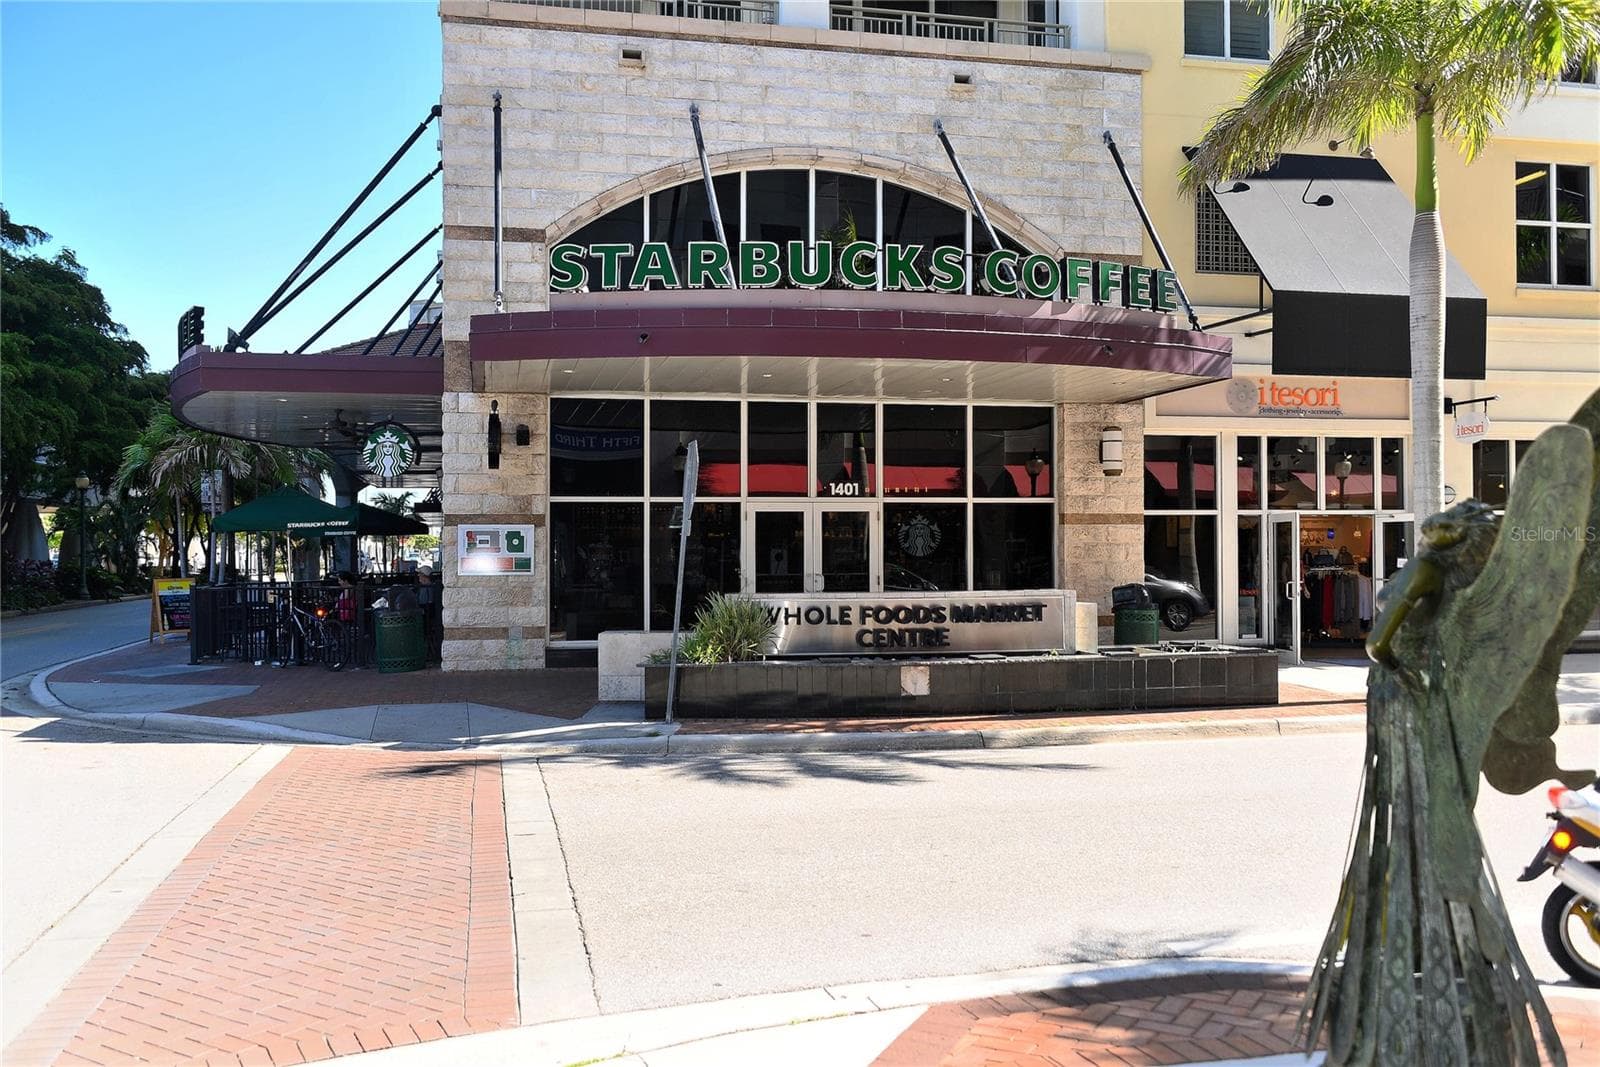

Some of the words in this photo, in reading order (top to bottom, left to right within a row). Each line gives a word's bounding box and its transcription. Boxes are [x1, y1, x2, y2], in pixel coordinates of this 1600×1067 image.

[549, 240, 967, 293] STARBUCKS
[981, 248, 1179, 312] COFFEE
[1257, 378, 1268, 406] i
[1270, 380, 1341, 407] tesori
[829, 482, 859, 496] 1401
[859, 604, 948, 626] FOODS
[950, 602, 1048, 624] MARKET
[855, 627, 950, 649] CENTRE
